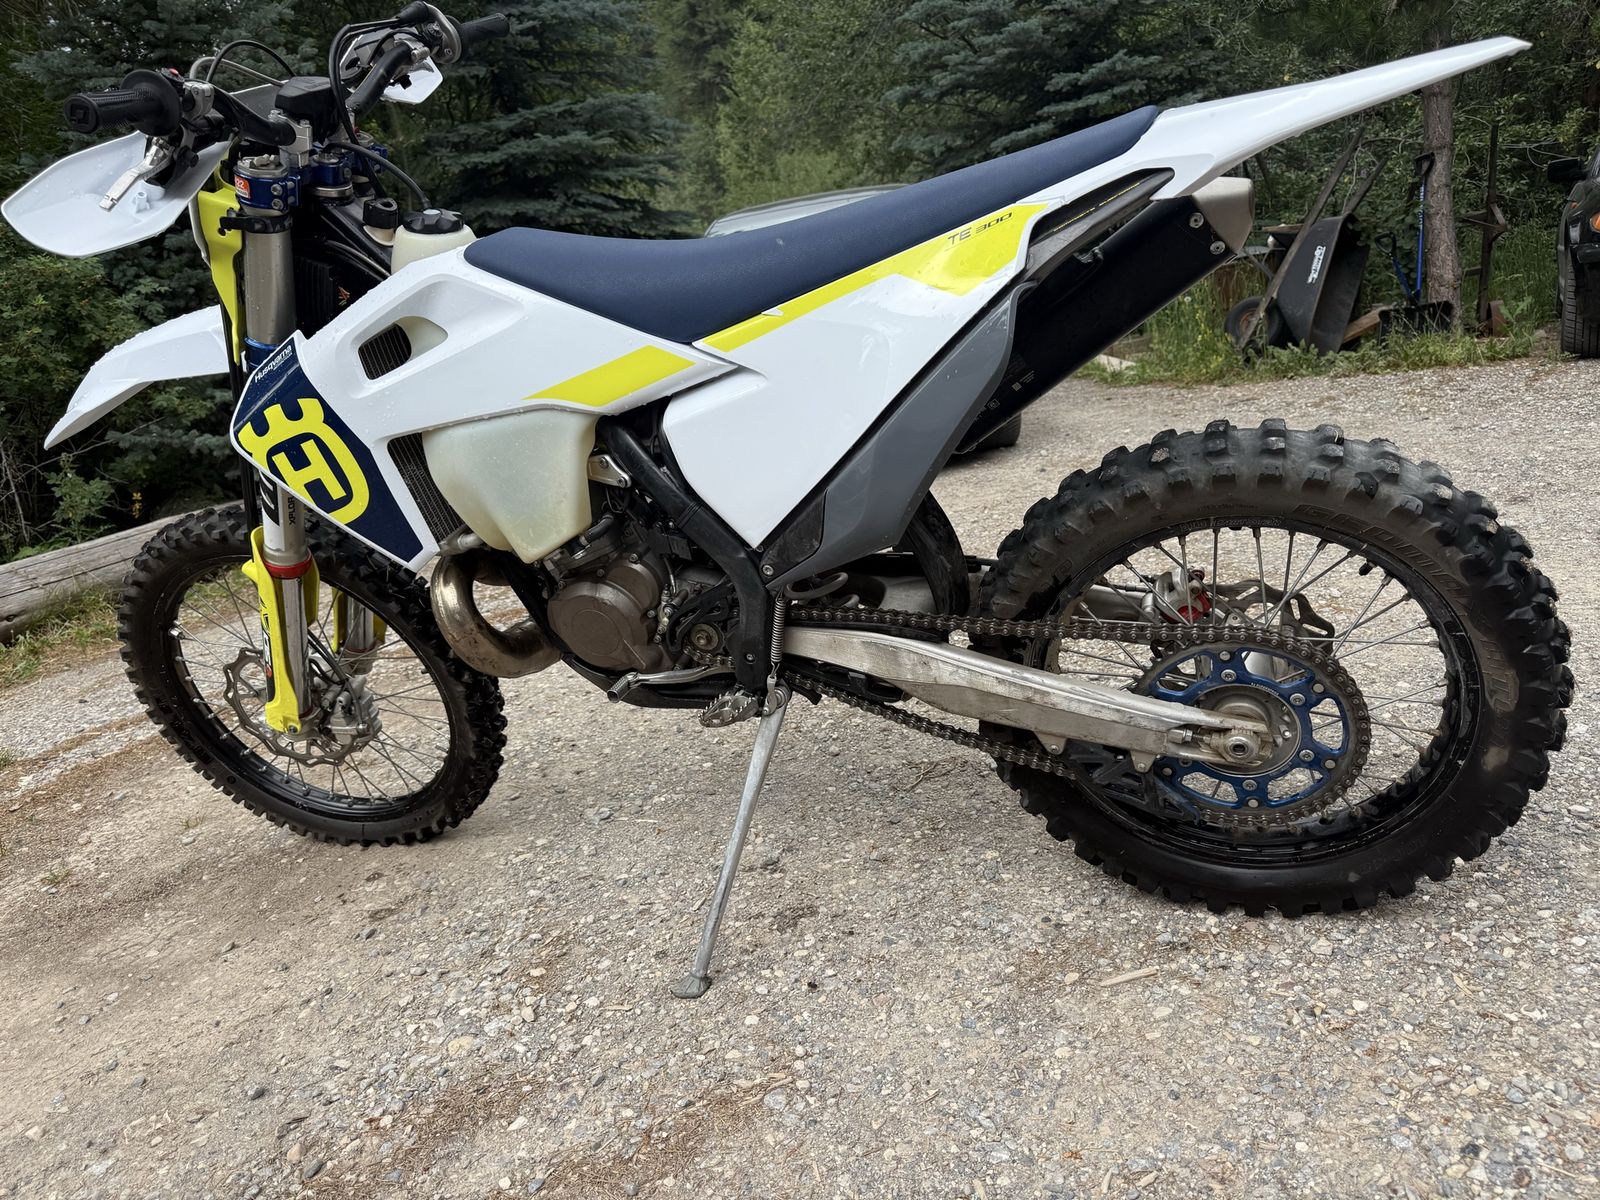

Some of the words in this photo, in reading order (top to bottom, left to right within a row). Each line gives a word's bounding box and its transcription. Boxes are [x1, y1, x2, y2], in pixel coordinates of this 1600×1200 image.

[948, 227, 972, 245] TE
[976, 212, 1013, 234] 300
[254, 344, 292, 383] Husqvarna
